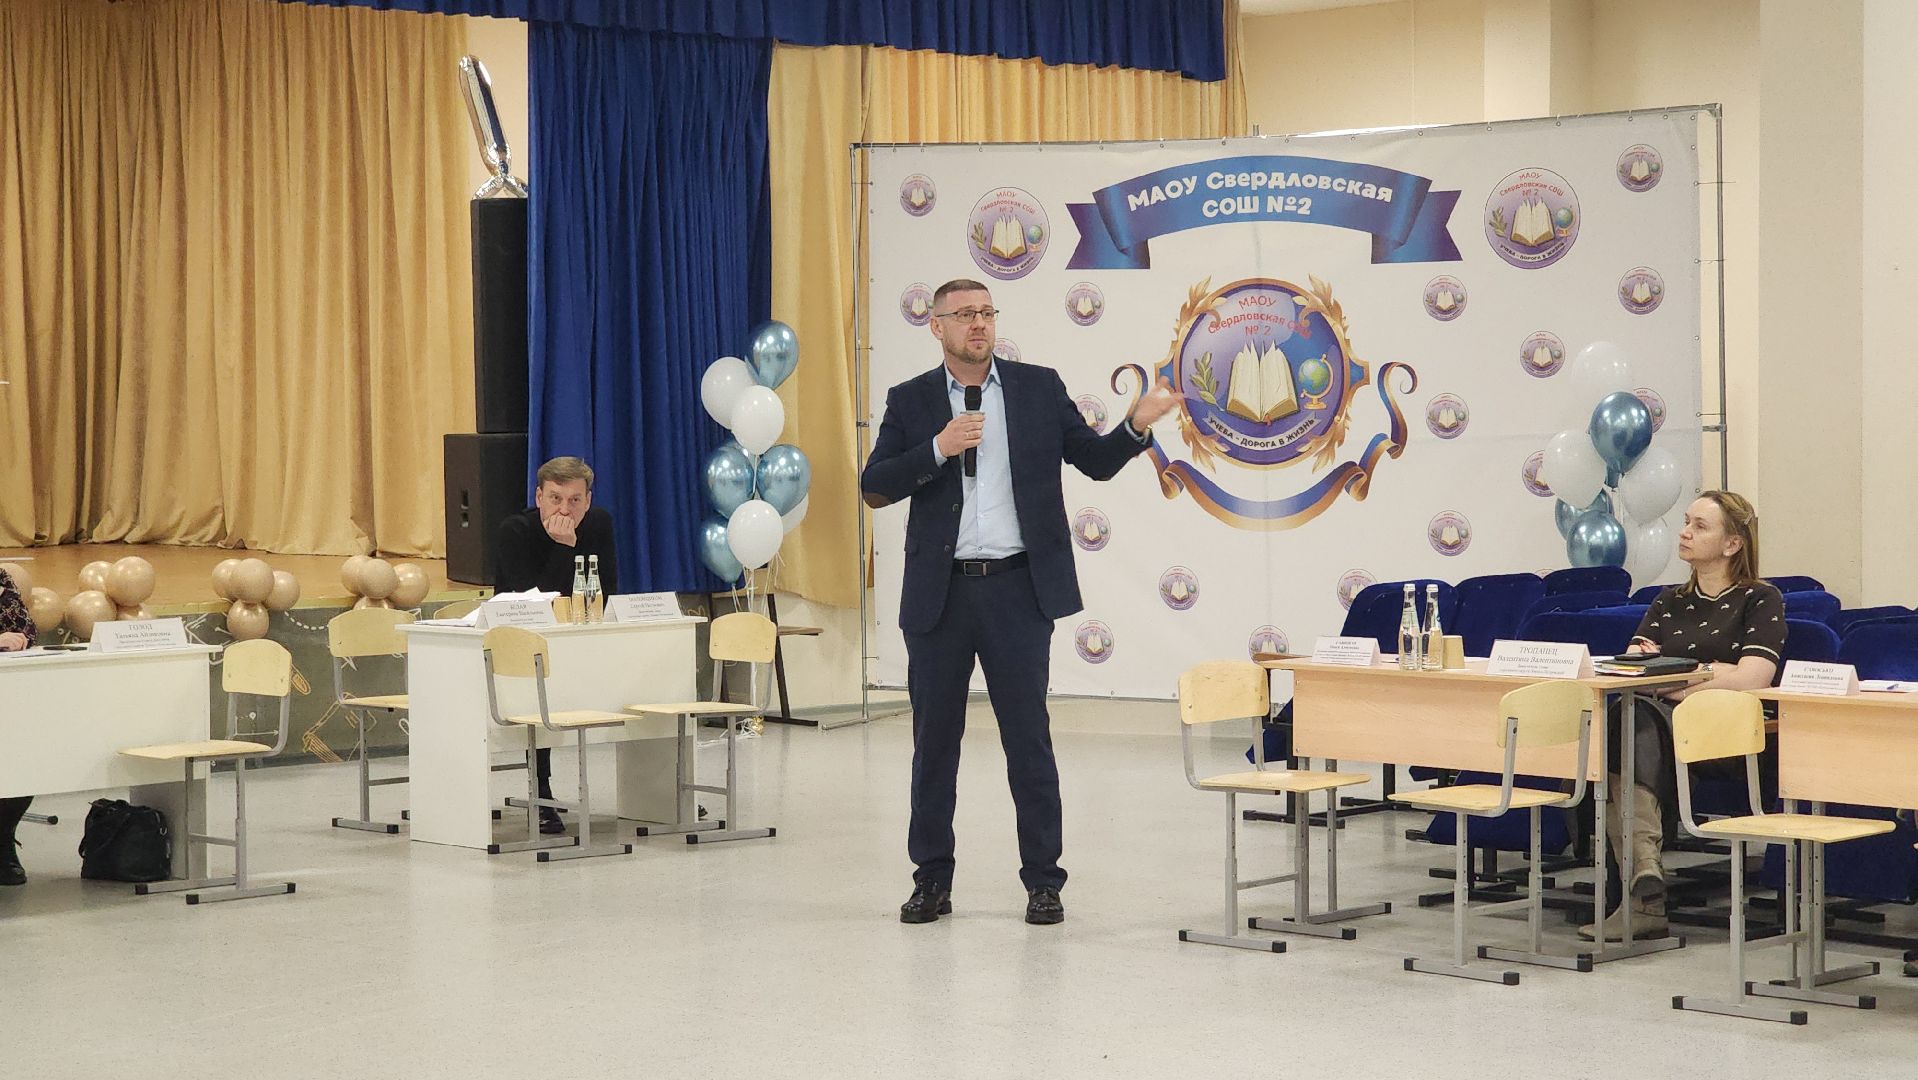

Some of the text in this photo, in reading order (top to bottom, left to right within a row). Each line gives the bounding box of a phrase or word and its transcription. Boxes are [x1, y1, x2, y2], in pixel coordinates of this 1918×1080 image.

[1127, 171, 1393, 212] МАОУ Свердловская
[1202, 195, 1313, 218] СОШ №2
[1238, 295, 1277, 310] МАОУ
[1263, 325, 1272, 336] 2
[1209, 417, 1235, 440] УЧЕБА
[1240, 437, 1277, 448] ДОРОГА
[1279, 438, 1286, 446] В
[1287, 418, 1315, 443] ЖИЗНЬ
